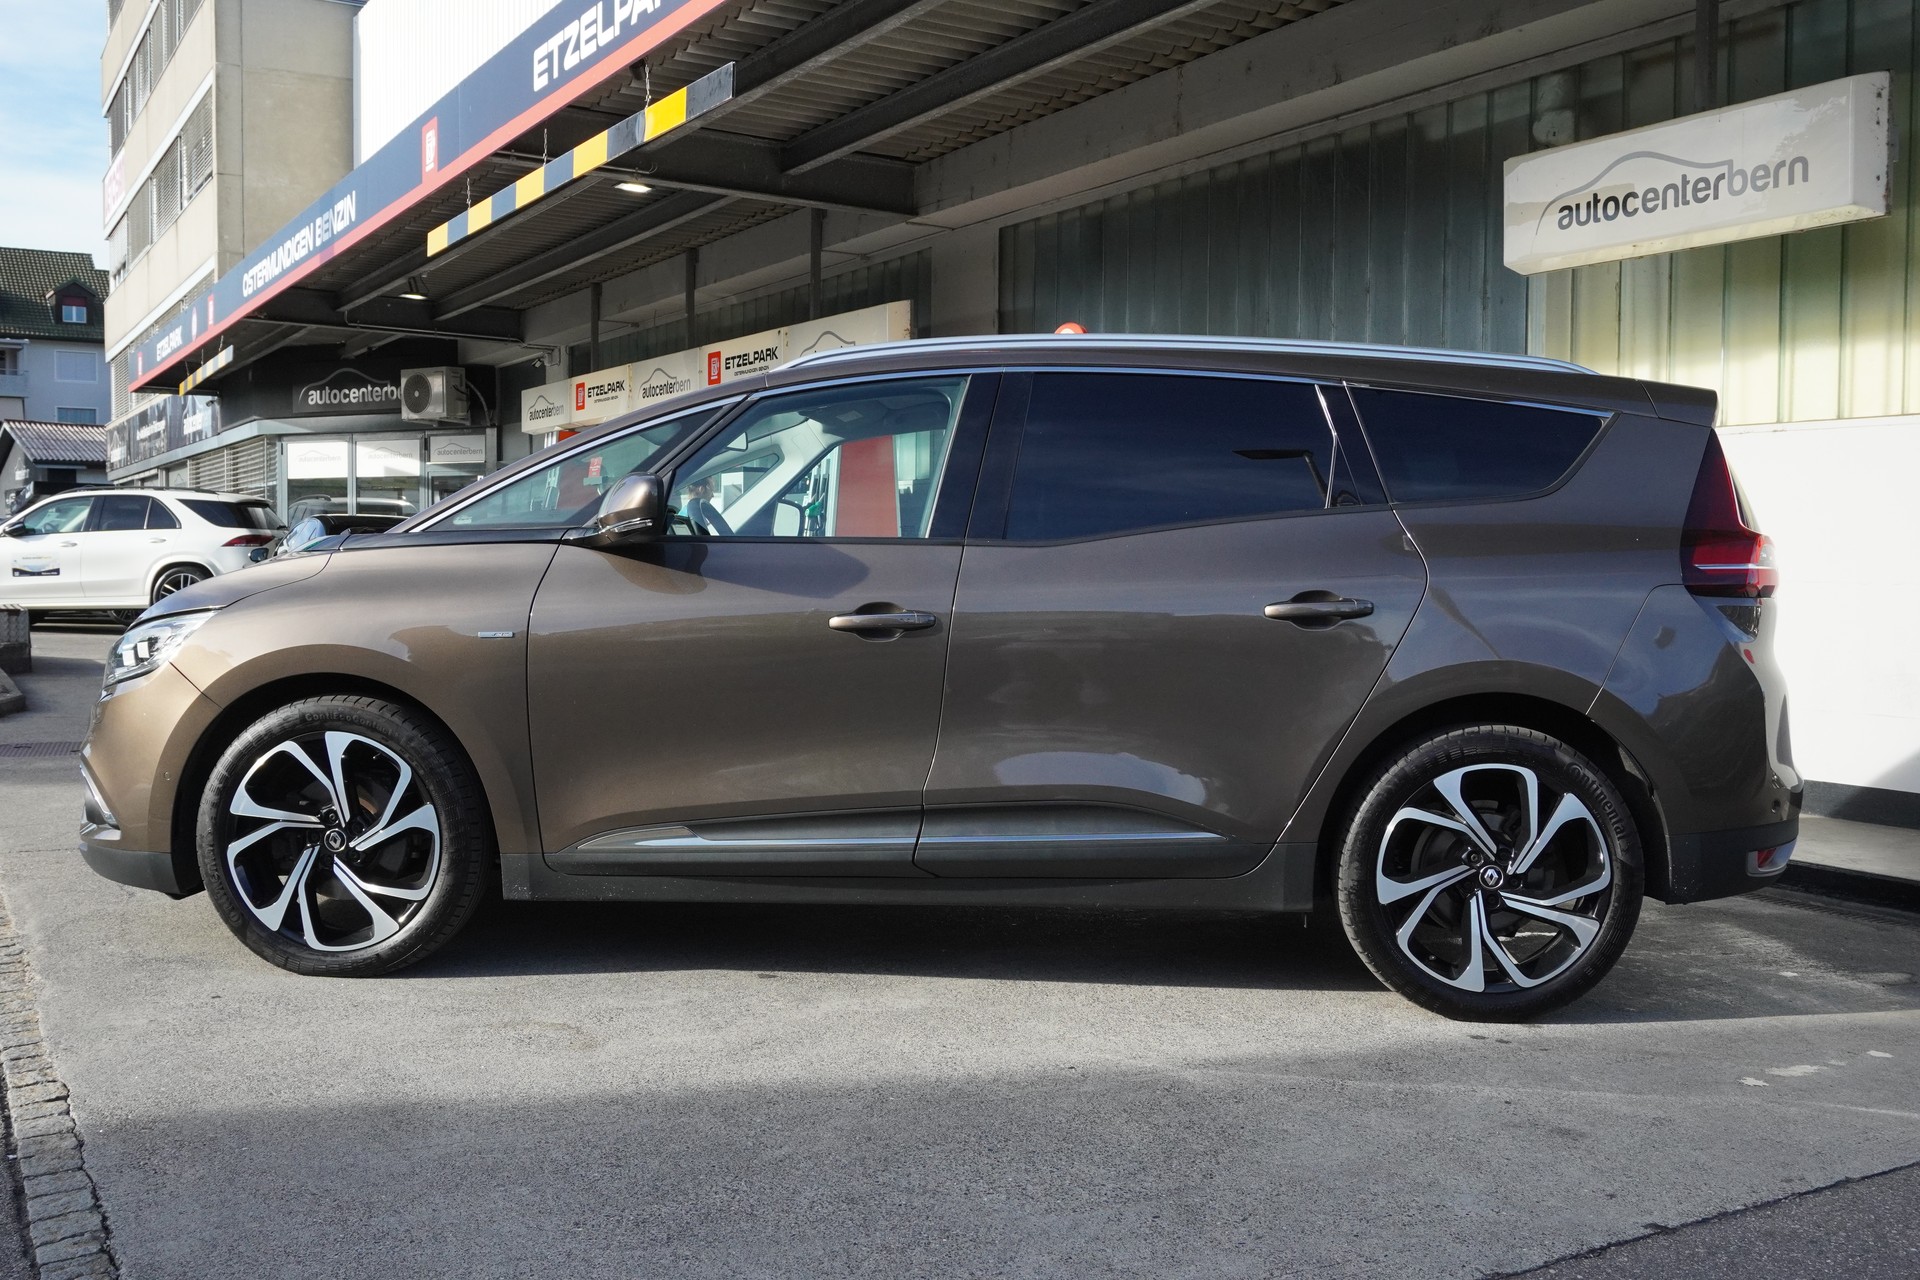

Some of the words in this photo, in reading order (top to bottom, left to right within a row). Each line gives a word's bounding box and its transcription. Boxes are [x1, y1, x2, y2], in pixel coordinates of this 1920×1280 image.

[1557, 155, 1809, 231] autocenterbern
[242, 222, 314, 298] OSTERMUNDIGEN
[315, 190, 356, 247] BENZIN
[725, 346, 778, 370] ETZELPARK
[587, 379, 625, 398] ETZELPARK
[641, 377, 691, 399] autocenterbern
[529, 403, 565, 421] autocenterbern
[437, 448, 483, 456] autocenterbern
